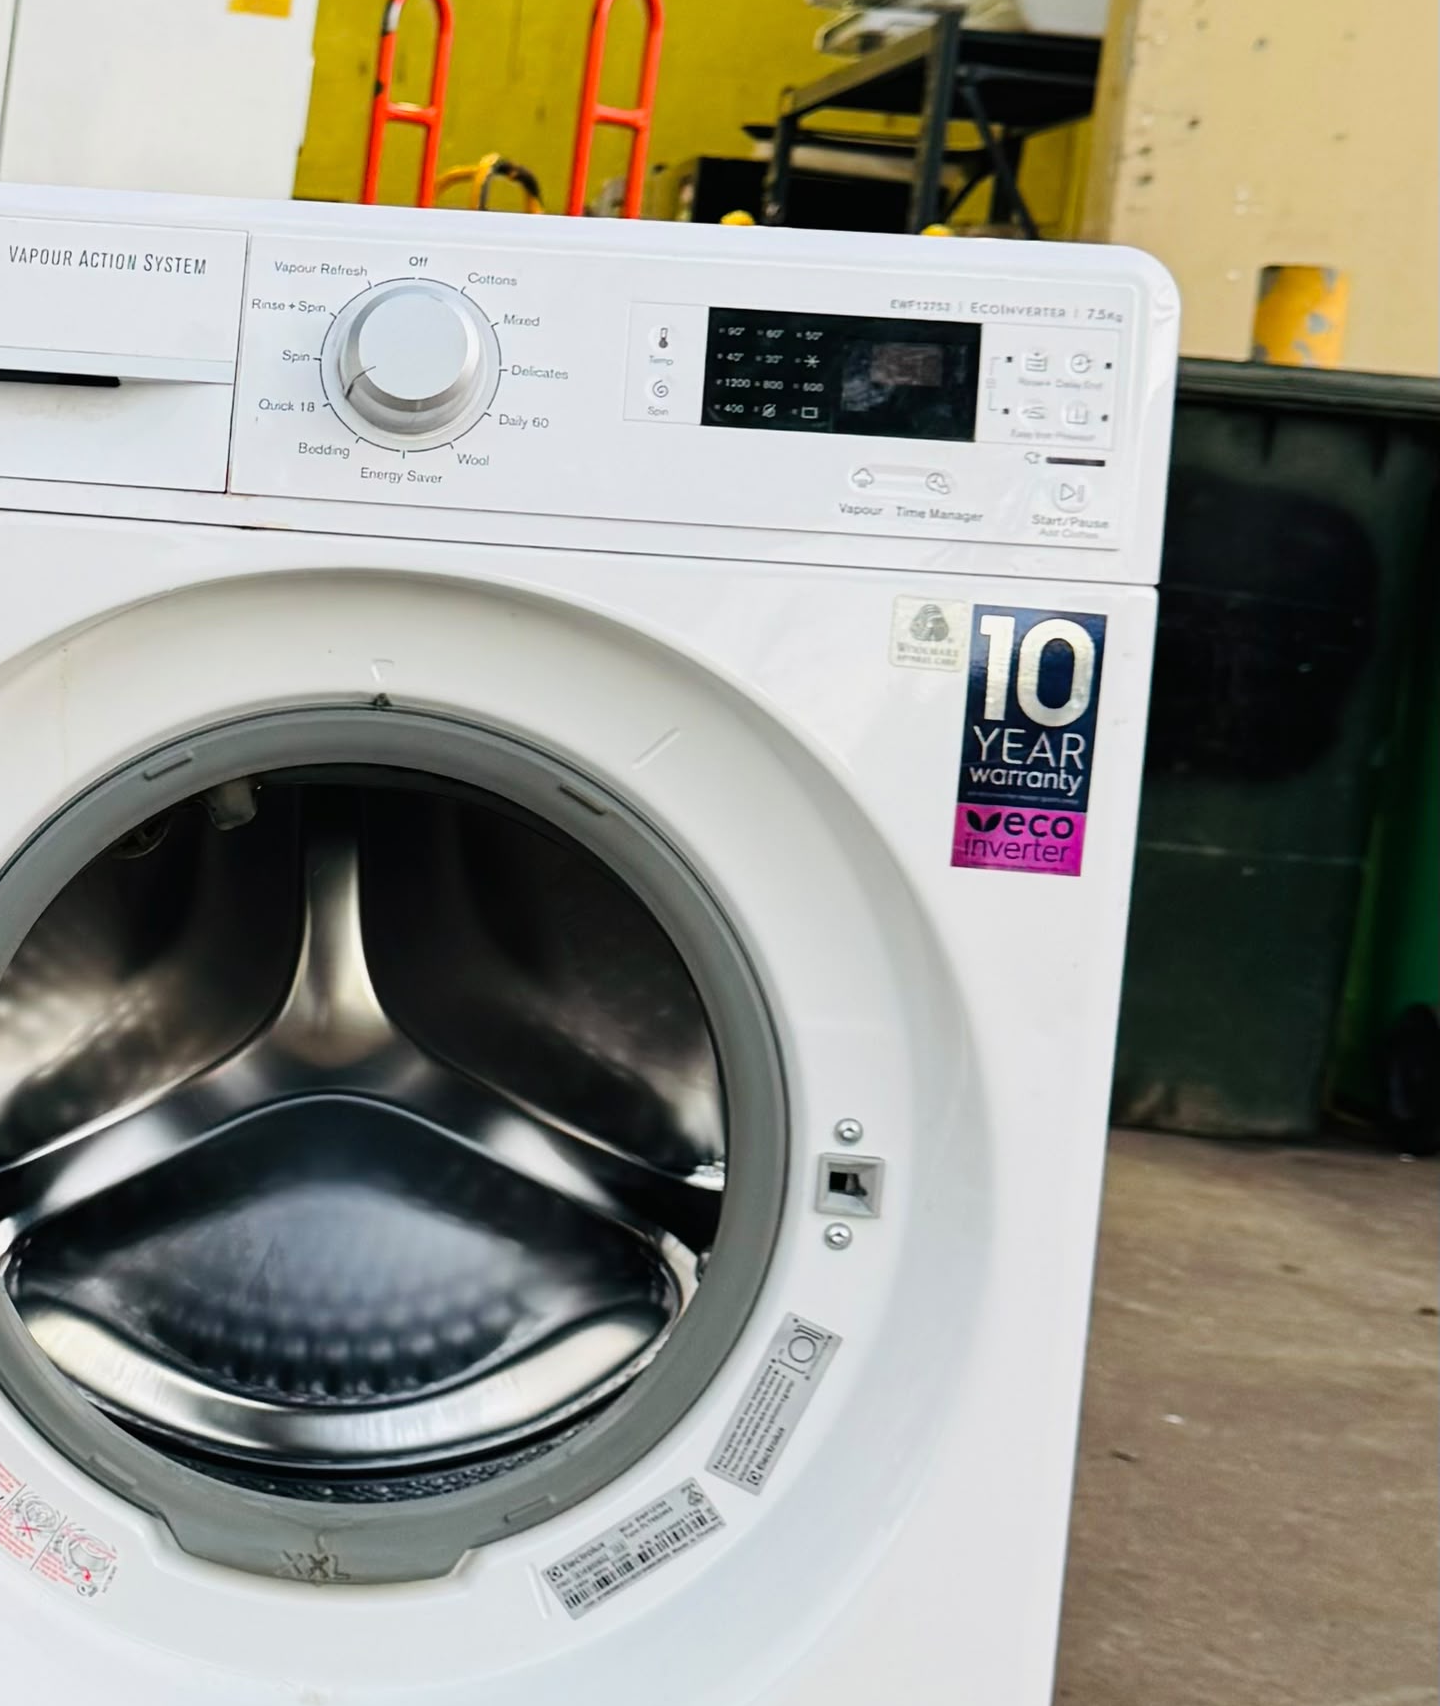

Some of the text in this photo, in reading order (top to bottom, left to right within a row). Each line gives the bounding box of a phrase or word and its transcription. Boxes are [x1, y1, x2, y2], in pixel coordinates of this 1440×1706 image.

[9, 245, 207, 275] VAPOUR ACTION SYSTEM
[274, 260, 368, 277] Vapour Refresh
[409, 256, 428, 267] Off
[467, 272, 518, 287] Cottons
[251, 298, 286, 311] Rinse
[298, 300, 326, 313] Spin
[503, 313, 541, 327] Mixed
[282, 349, 311, 363] Spin
[649, 355, 674, 367] Temp
[511, 364, 569, 380] Delicates
[258, 398, 315, 412] Quick 18
[647, 405, 669, 418] Spin
[498, 414, 549, 430] Daily 60
[298, 442, 351, 459] Bedding
[457, 453, 490, 466] Wool
[360, 467, 443, 484] Energy Saver
[838, 502, 985, 524] Vapour Time Manager
[1032, 513, 1110, 530] Start/Pause
[978, 613, 1096, 728] 10
[973, 725, 1087, 771] YEAR
[969, 766, 1084, 797] warranty
[1003, 812, 1075, 840] eco
[963, 833, 1071, 863] inverter
[756, 1427, 786, 1472] Electrolux
[276, 1549, 352, 1582] XXL
[561, 1541, 606, 1573] Electrolux
